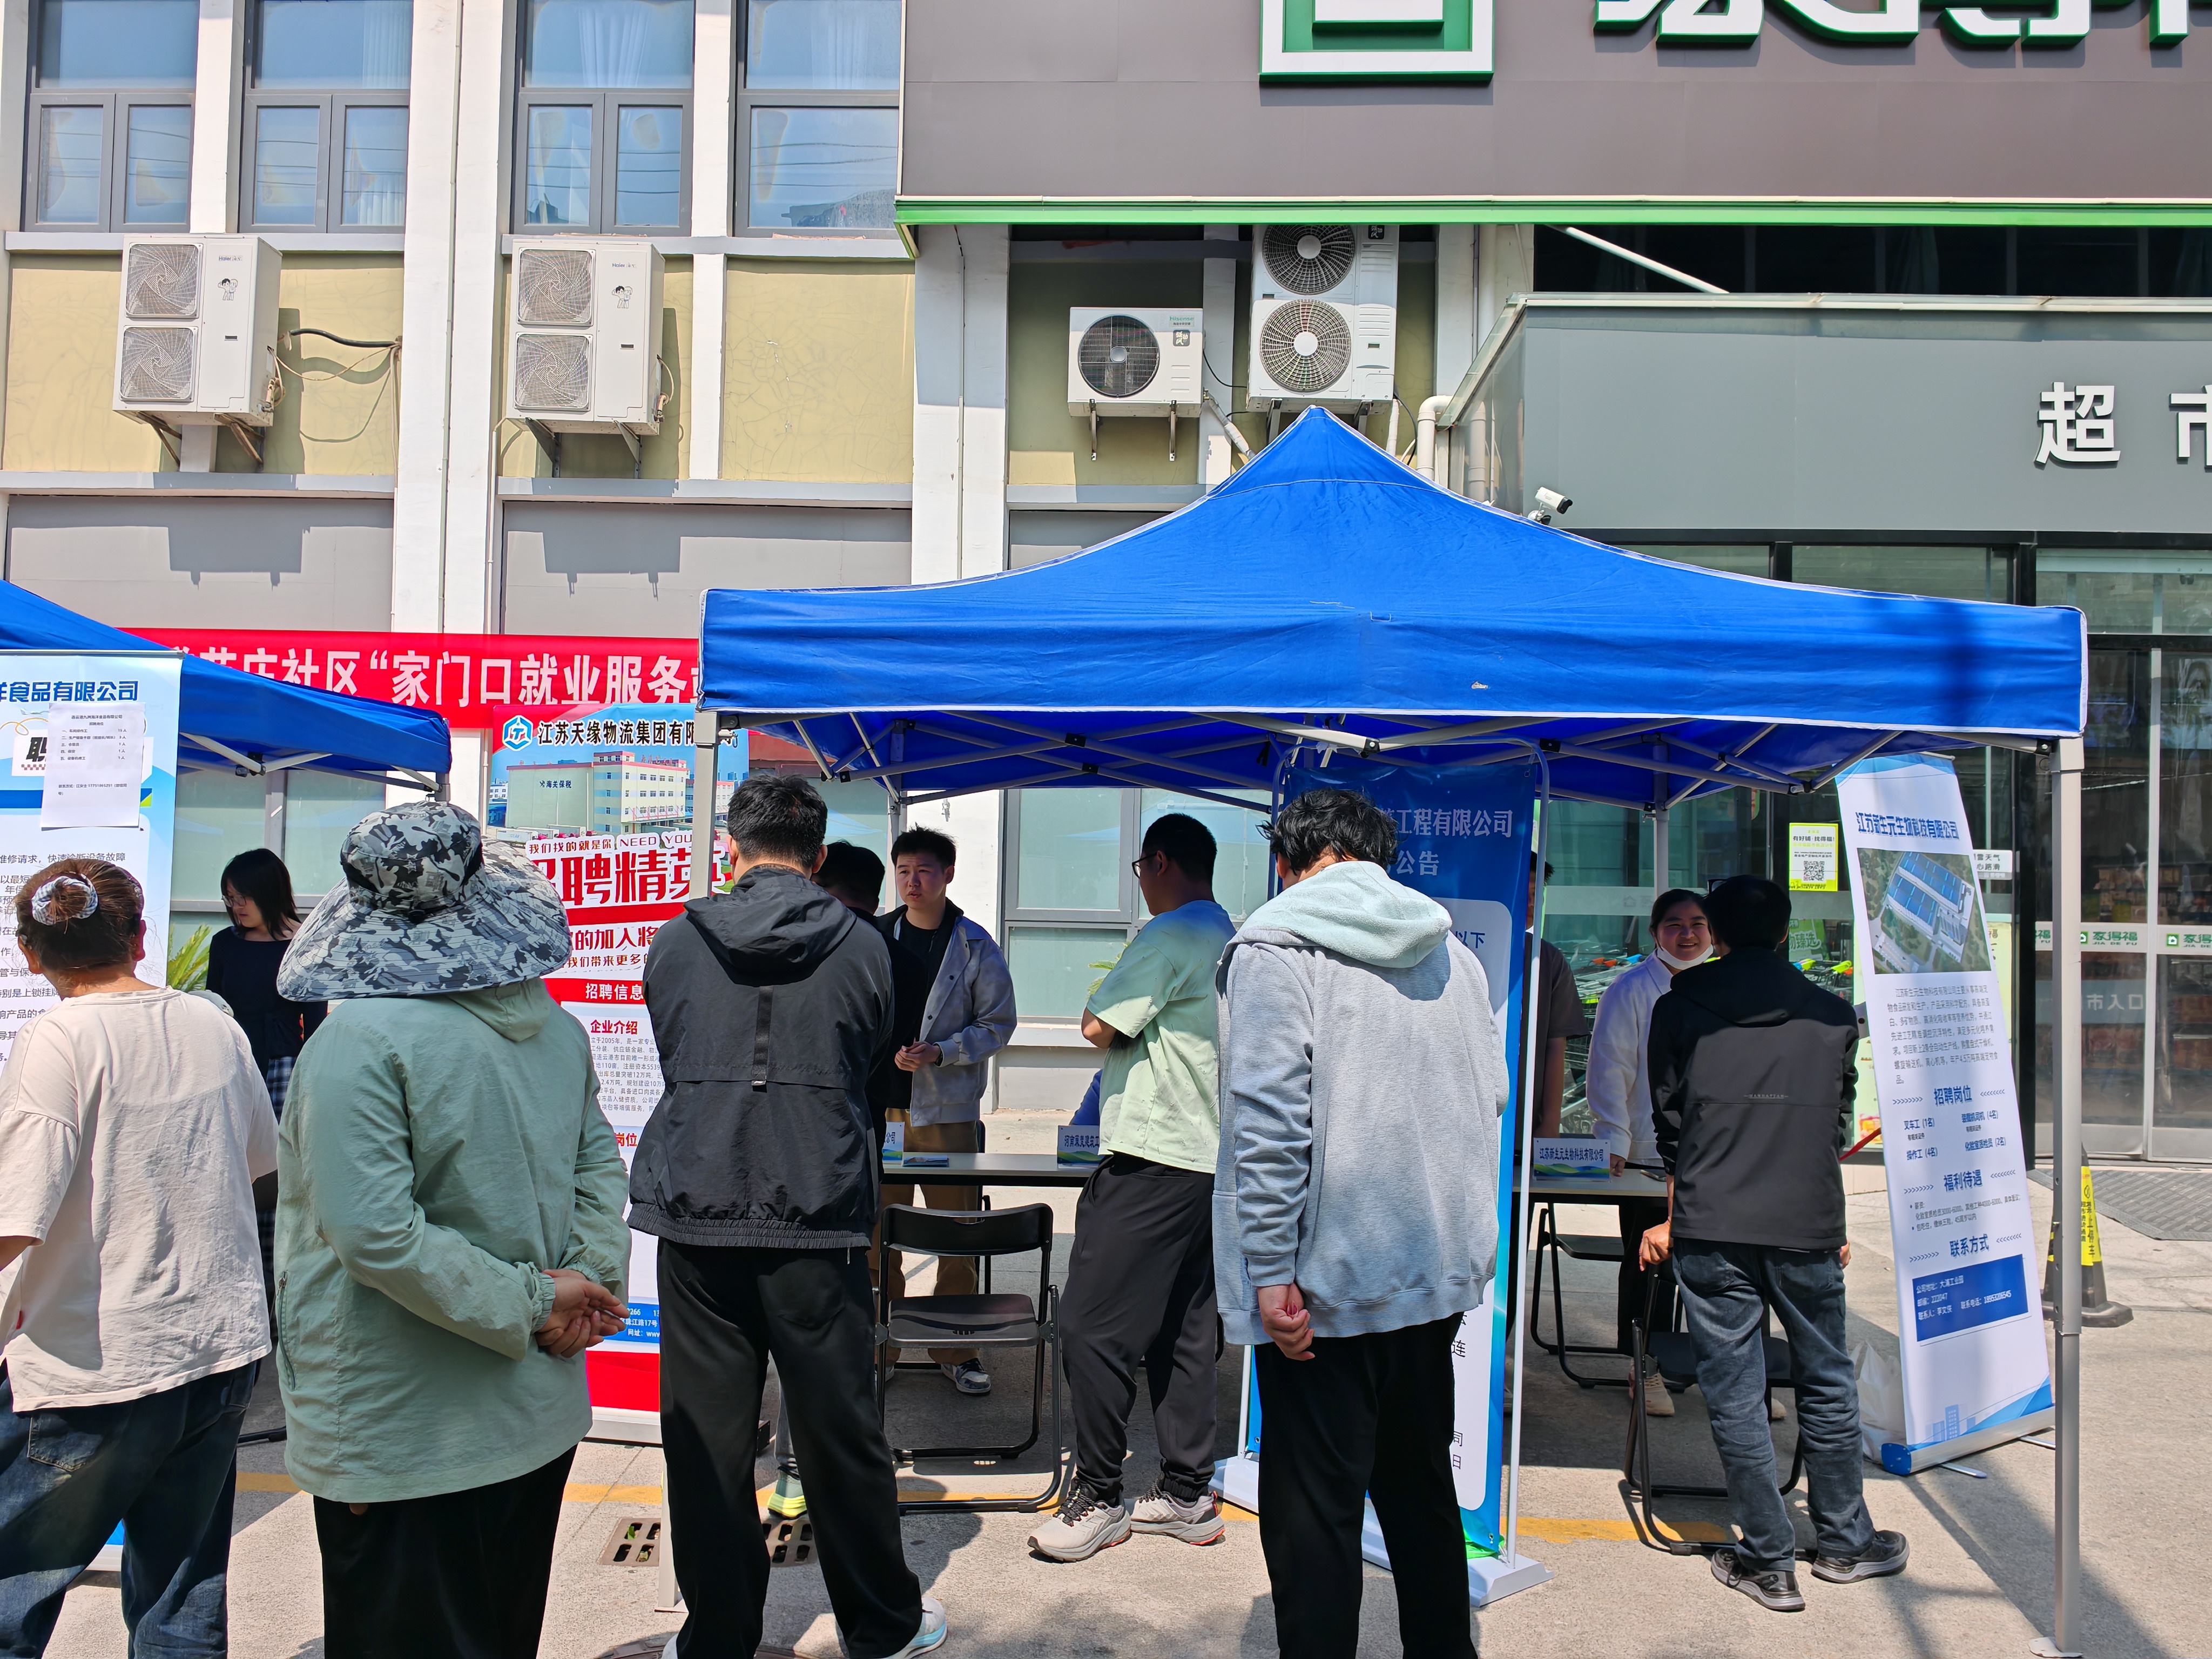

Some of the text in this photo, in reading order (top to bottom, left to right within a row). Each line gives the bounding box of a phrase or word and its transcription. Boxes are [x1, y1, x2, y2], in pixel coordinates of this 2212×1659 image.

[538, 721, 732, 745] 江苏天缘物流集团有限
[547, 780, 571, 788] 海关保税
[1381, 808, 1513, 838] 工程有限公司
[1856, 812, 1959, 840] 江苏新生元生物科技有限公司
[529, 838, 612, 854] 我们找的就是你
[620, 836, 657, 847] NEED
[1387, 850, 1439, 876] 公告
[1974, 853, 2000, 861] 雪天气
[1, 875, 32, 884] 以最短
[570, 926, 659, 950] 的加入将
[2183, 932, 2212, 943] 家得
[561, 953, 648, 968] 我们带来更多
[585, 982, 644, 1000] 招聘信息
[2081, 994, 2143, 1010] 市入口
[590, 1020, 638, 1035] 企业介绍
[1934, 1085, 1972, 1106] 招聘岗位
[885, 1132, 895, 1144] 公司
[1944, 1169, 1983, 1192] 福利待遇
[1950, 1233, 1990, 1257] 联系方式
[1452, 1454, 1461, 1469] 日
